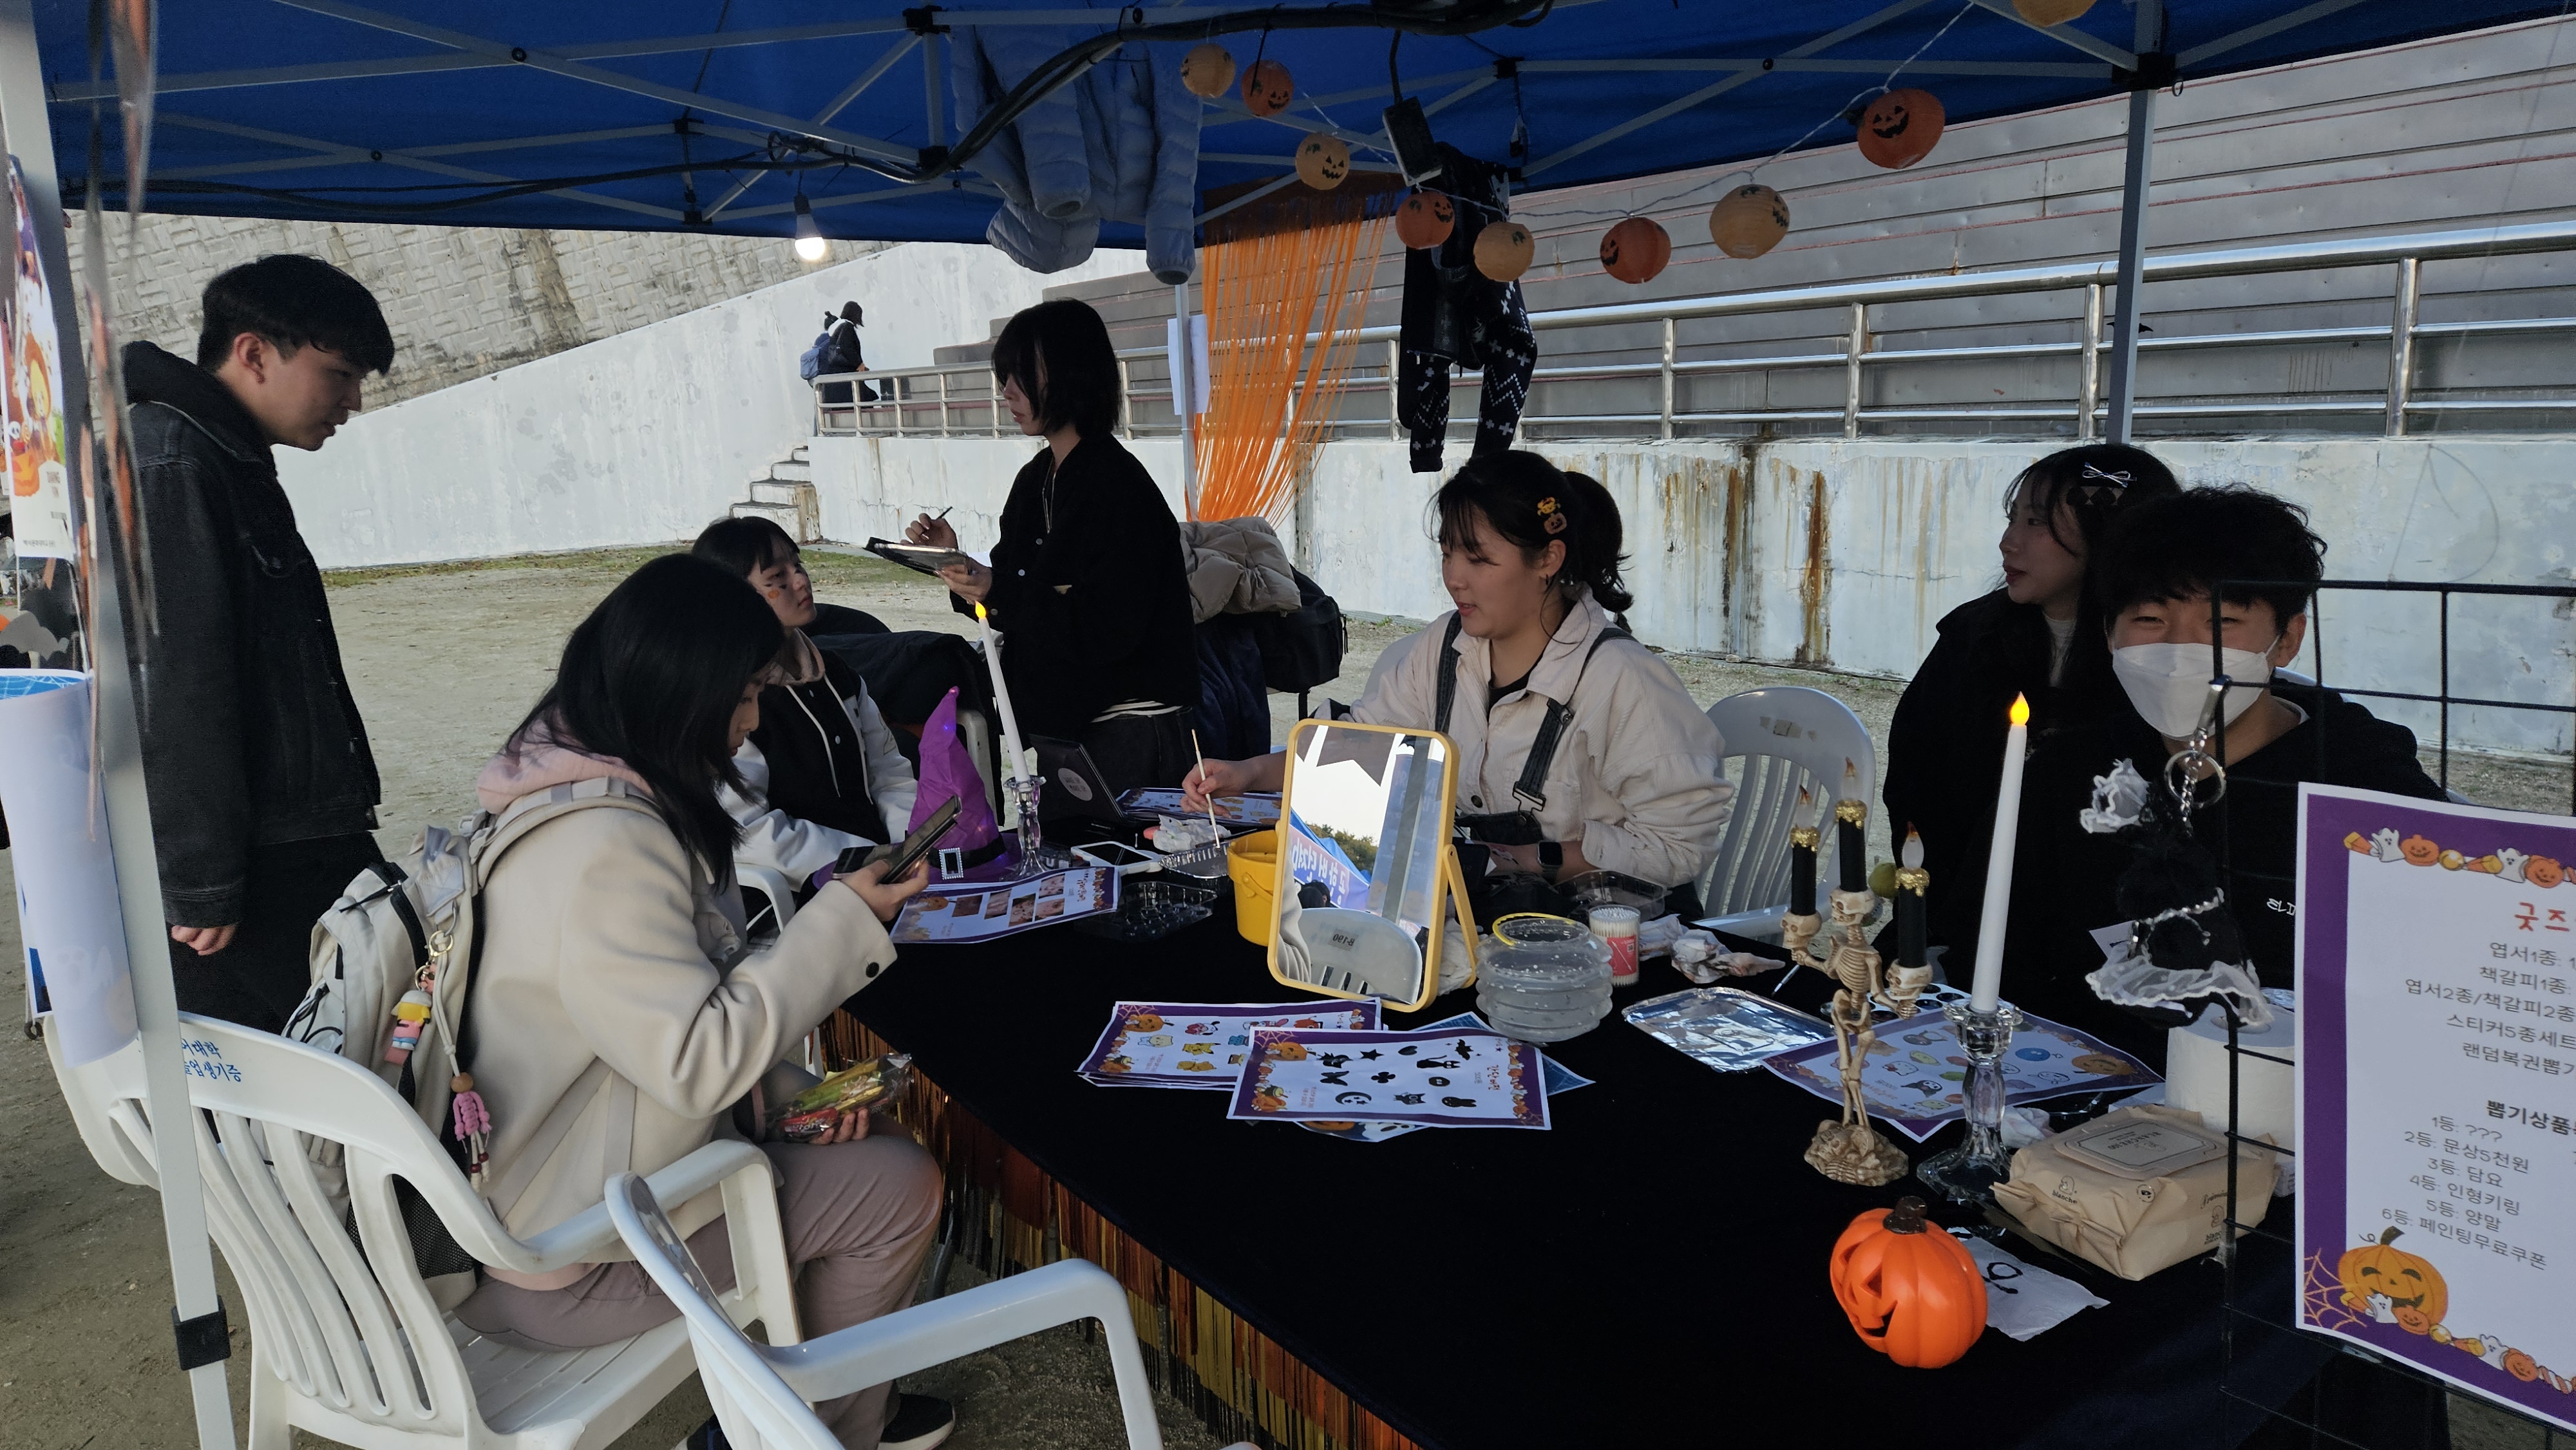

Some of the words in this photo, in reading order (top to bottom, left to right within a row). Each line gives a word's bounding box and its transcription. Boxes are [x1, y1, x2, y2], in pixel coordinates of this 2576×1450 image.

[2490, 941, 2562, 967] 엽서1종:
[2479, 966, 2571, 995] 책갈피1종:
[2405, 978, 2576, 1024] 엽서2종/책갈피2종
[2447, 1014, 2576, 1051] 스티커5종세트
[2432, 1115, 2459, 1133] 1등:
[2465, 1124, 2503, 1143] ???
[2486, 1100, 2576, 1137] 뽑기상품
[2403, 1131, 2437, 1149] 2등:
[2443, 1138, 2530, 1174] 문상5천원
[2427, 1158, 2461, 1177] 3등:
[2467, 1166, 2504, 1189] 담요
[2052, 1190, 2078, 1205] blanche
[2409, 1174, 2441, 1192] 4등:
[2447, 1183, 2521, 1216] 인형키링
[2425, 1199, 2459, 1219] 5등:
[2465, 1209, 2503, 1233] 양말
[2381, 1208, 2414, 1227] 6등:
[2420, 1217, 2548, 1271] 페인팅무료쿠폰
